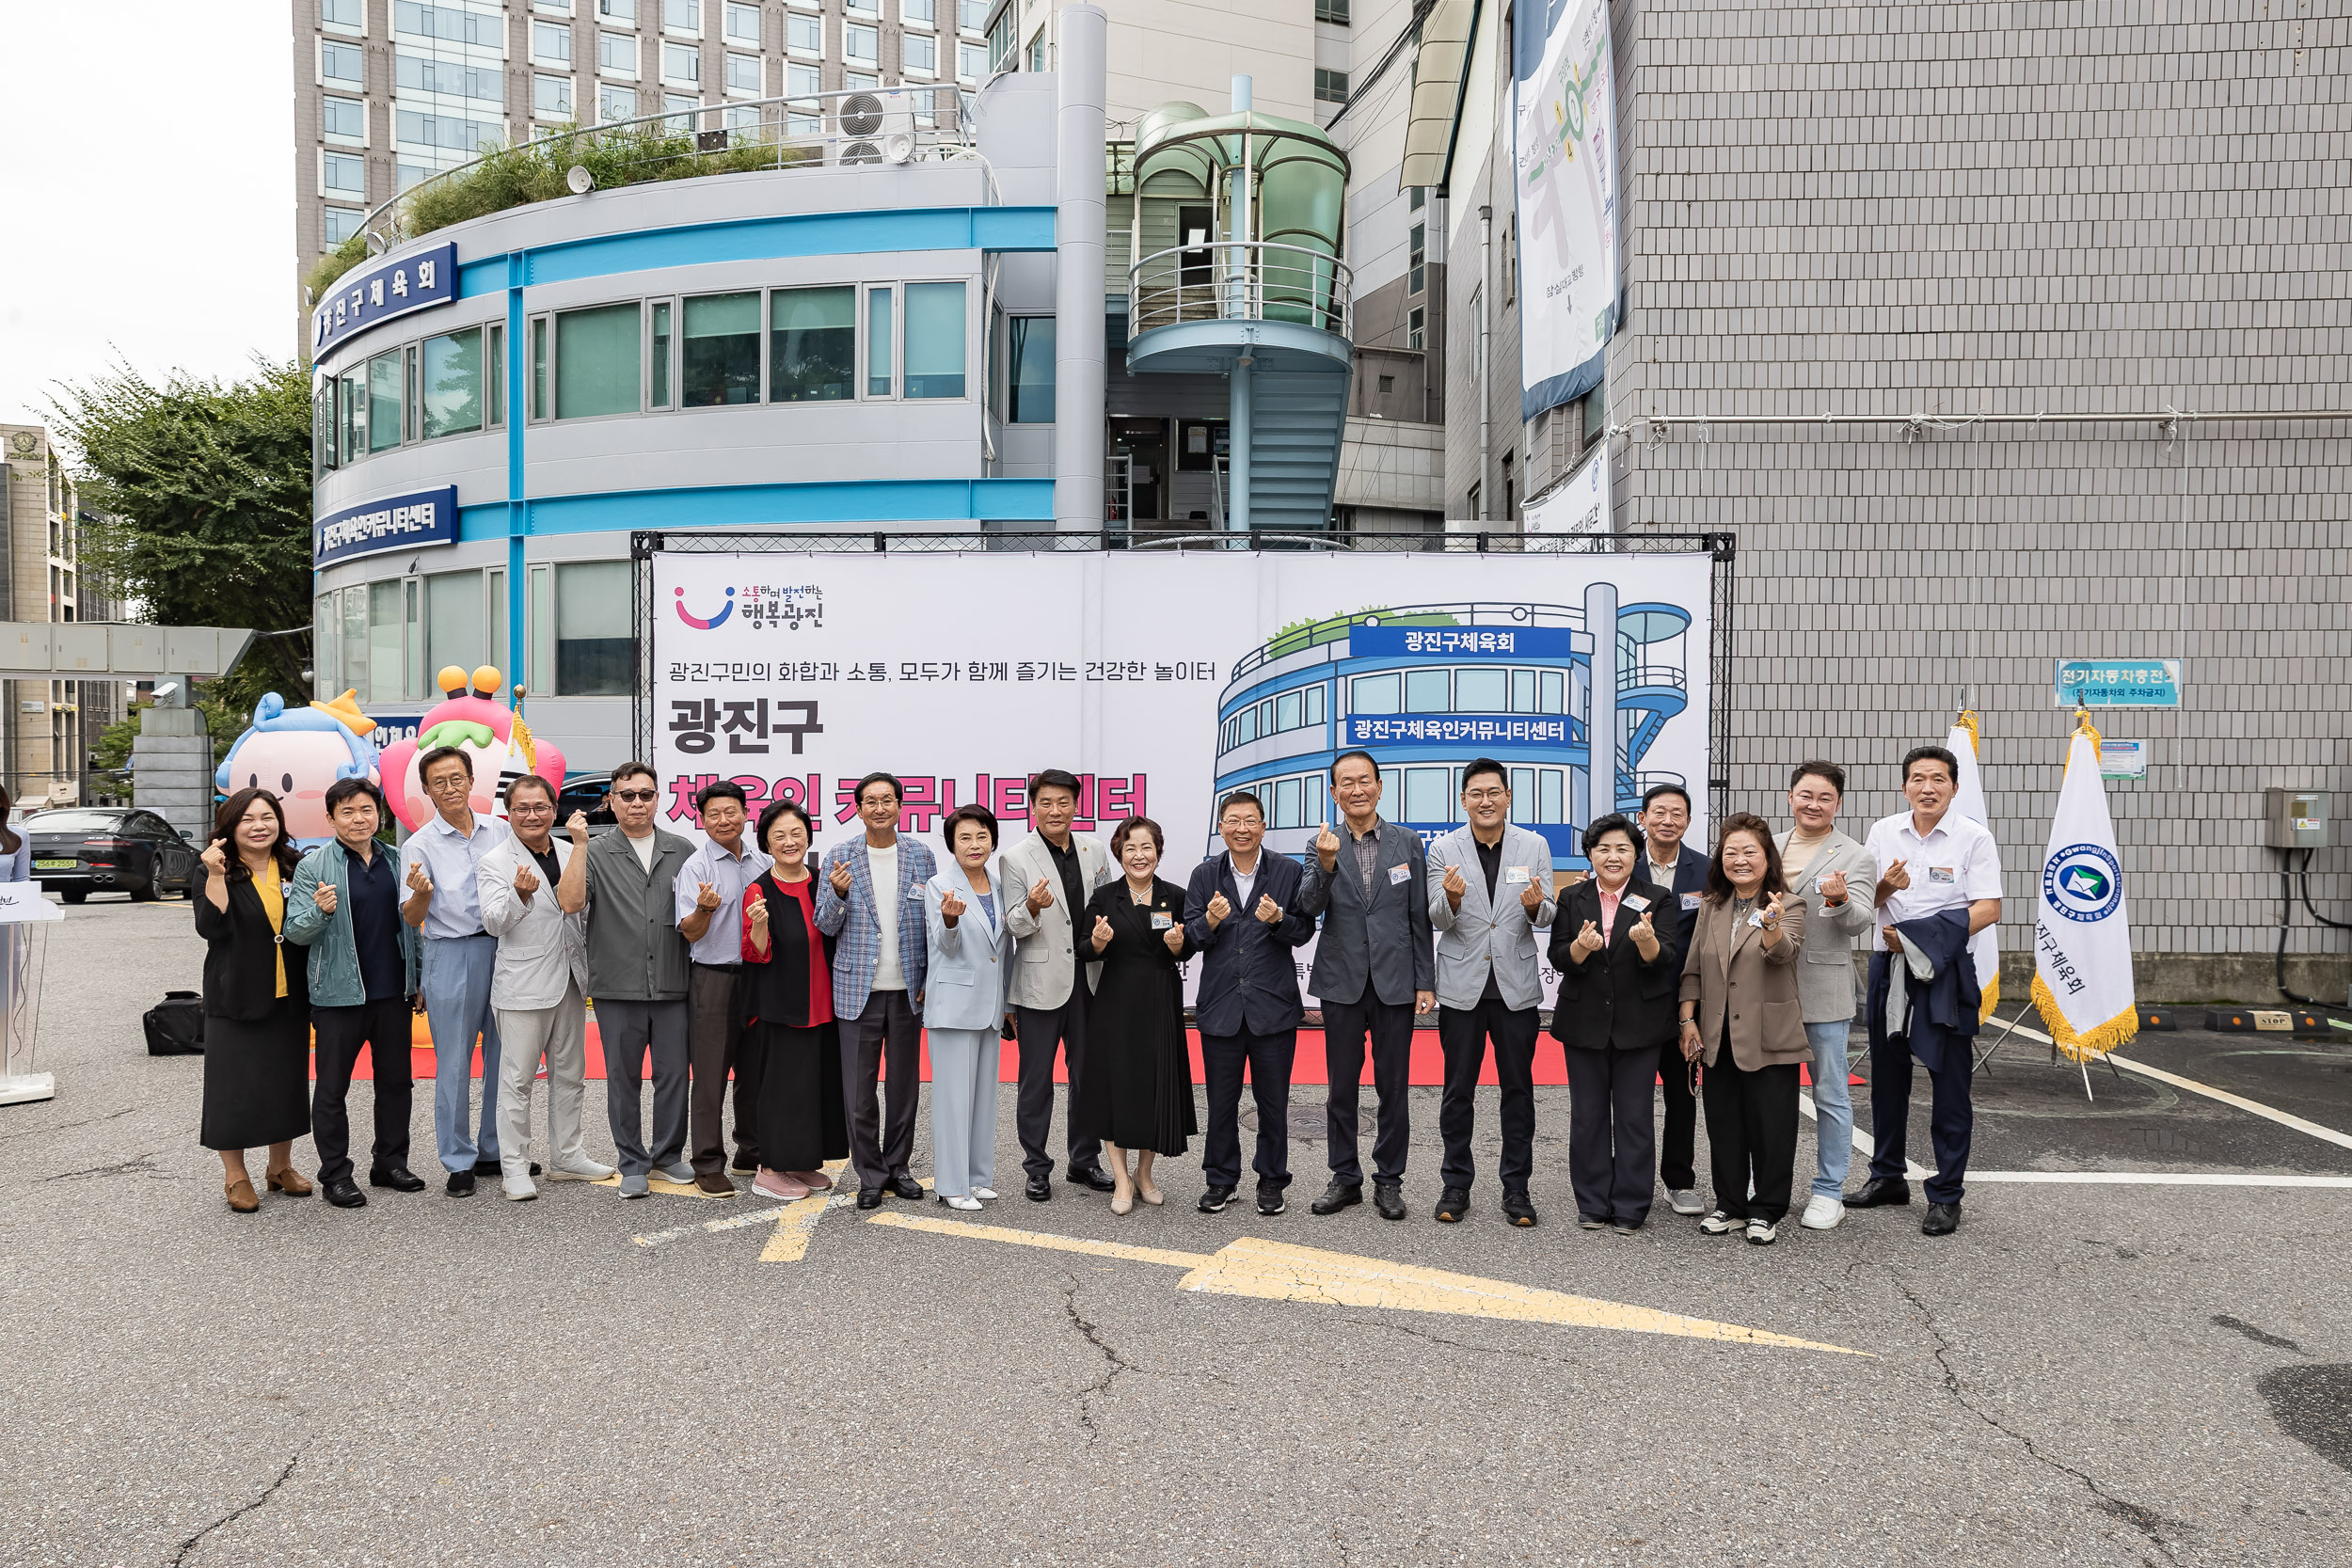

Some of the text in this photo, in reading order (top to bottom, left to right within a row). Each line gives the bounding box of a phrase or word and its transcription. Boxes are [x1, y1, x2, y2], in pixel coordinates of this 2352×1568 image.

[323, 260, 436, 336] 광진구체육회
[324, 502, 436, 552] 광진구체육인커뮤니티센터
[741, 584, 823, 603] 소통하며 발전하는
[741, 601, 823, 631] 행복광진
[1405, 631, 1515, 653] 광진구체육회
[669, 660, 1216, 683] 광진구민의 화합과 소통, 모두가 함께 즐기는 건강한 놀이터
[669, 698, 823, 754] 광진구
[1354, 720, 1565, 741] 광진구체육인커뮤니티센터
[2035, 918, 2086, 995] 진구체육회
